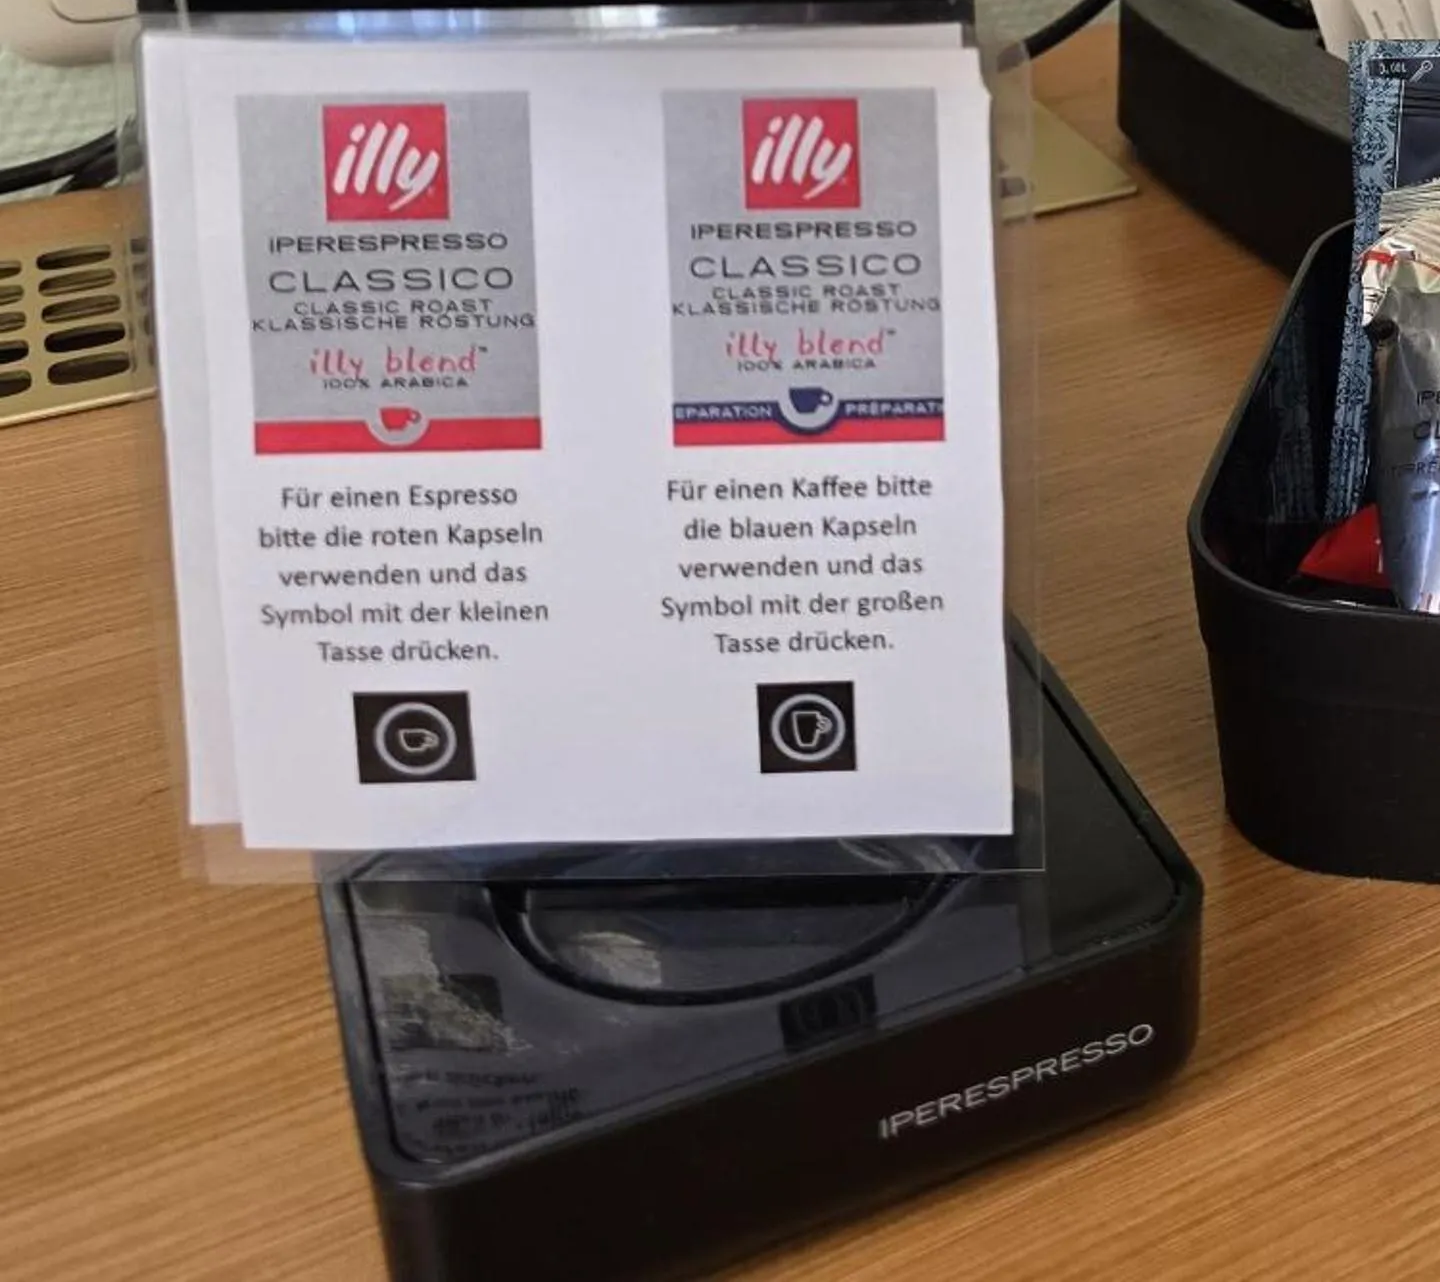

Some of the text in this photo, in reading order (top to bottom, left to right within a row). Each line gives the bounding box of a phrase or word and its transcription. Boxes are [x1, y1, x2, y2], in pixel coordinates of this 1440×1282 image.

[332, 119, 441, 212] illy
[751, 114, 853, 200] illy
[269, 232, 508, 253] IPERESPRESSO
[691, 220, 918, 241] IPERESPRESSO
[690, 253, 922, 280] CLASSICO
[268, 267, 514, 294] CLASSICO
[712, 283, 901, 300] CLASSIC ROAST
[293, 298, 493, 316] CLASSIC ROAST
[672, 300, 820, 317] KLASSISCHE
[252, 316, 408, 332] KLASSISCHE
[726, 331, 778, 363] illy
[309, 348, 364, 380] illy
[737, 358, 876, 372] 100% ARABICA
[323, 376, 469, 390] 100% ARABICA
[281, 484, 518, 510] Für einen Espresso
[667, 474, 933, 502] Für einen Kaffee bitte
[258, 521, 543, 550] bitte die roten Kapseln
[683, 513, 917, 542] die blauen Kapseln
[278, 562, 528, 587] verwenden und das
[678, 553, 923, 579] verwenden und das
[260, 600, 549, 630] Symbol mit der kleinen
[661, 589, 944, 622] Symbol mit der großen
[317, 638, 499, 663] Tasse drücken.
[714, 629, 895, 655] Tasse drücken.
[879, 1023, 1155, 1140] IPERESPRESSO
